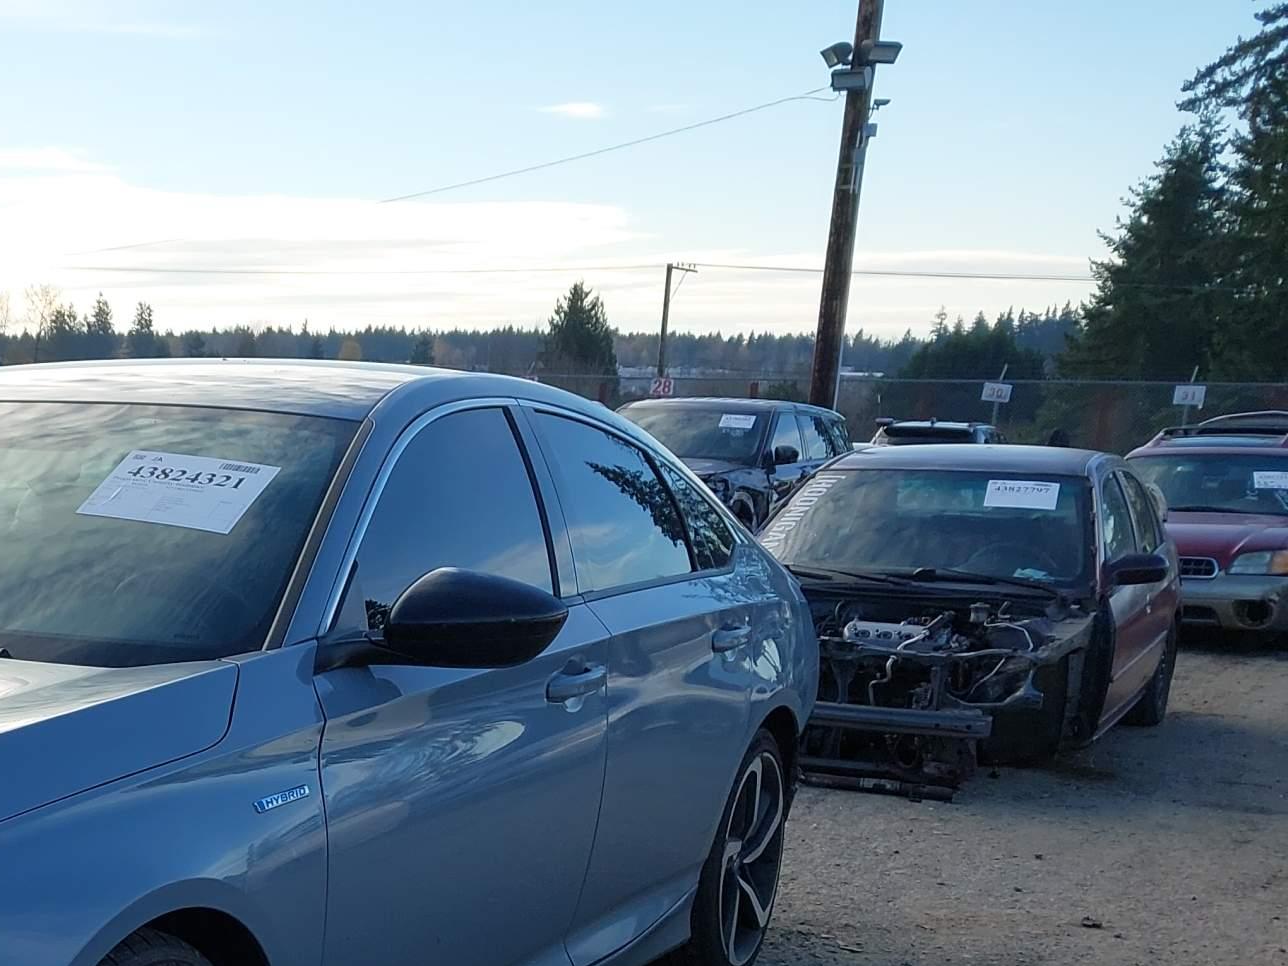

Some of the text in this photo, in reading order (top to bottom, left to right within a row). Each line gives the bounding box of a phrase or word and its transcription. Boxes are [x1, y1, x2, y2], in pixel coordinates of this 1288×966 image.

[652, 379, 672, 394] 28
[128, 466, 245, 489] 43824321
[265, 787, 306, 808] HYBRID
